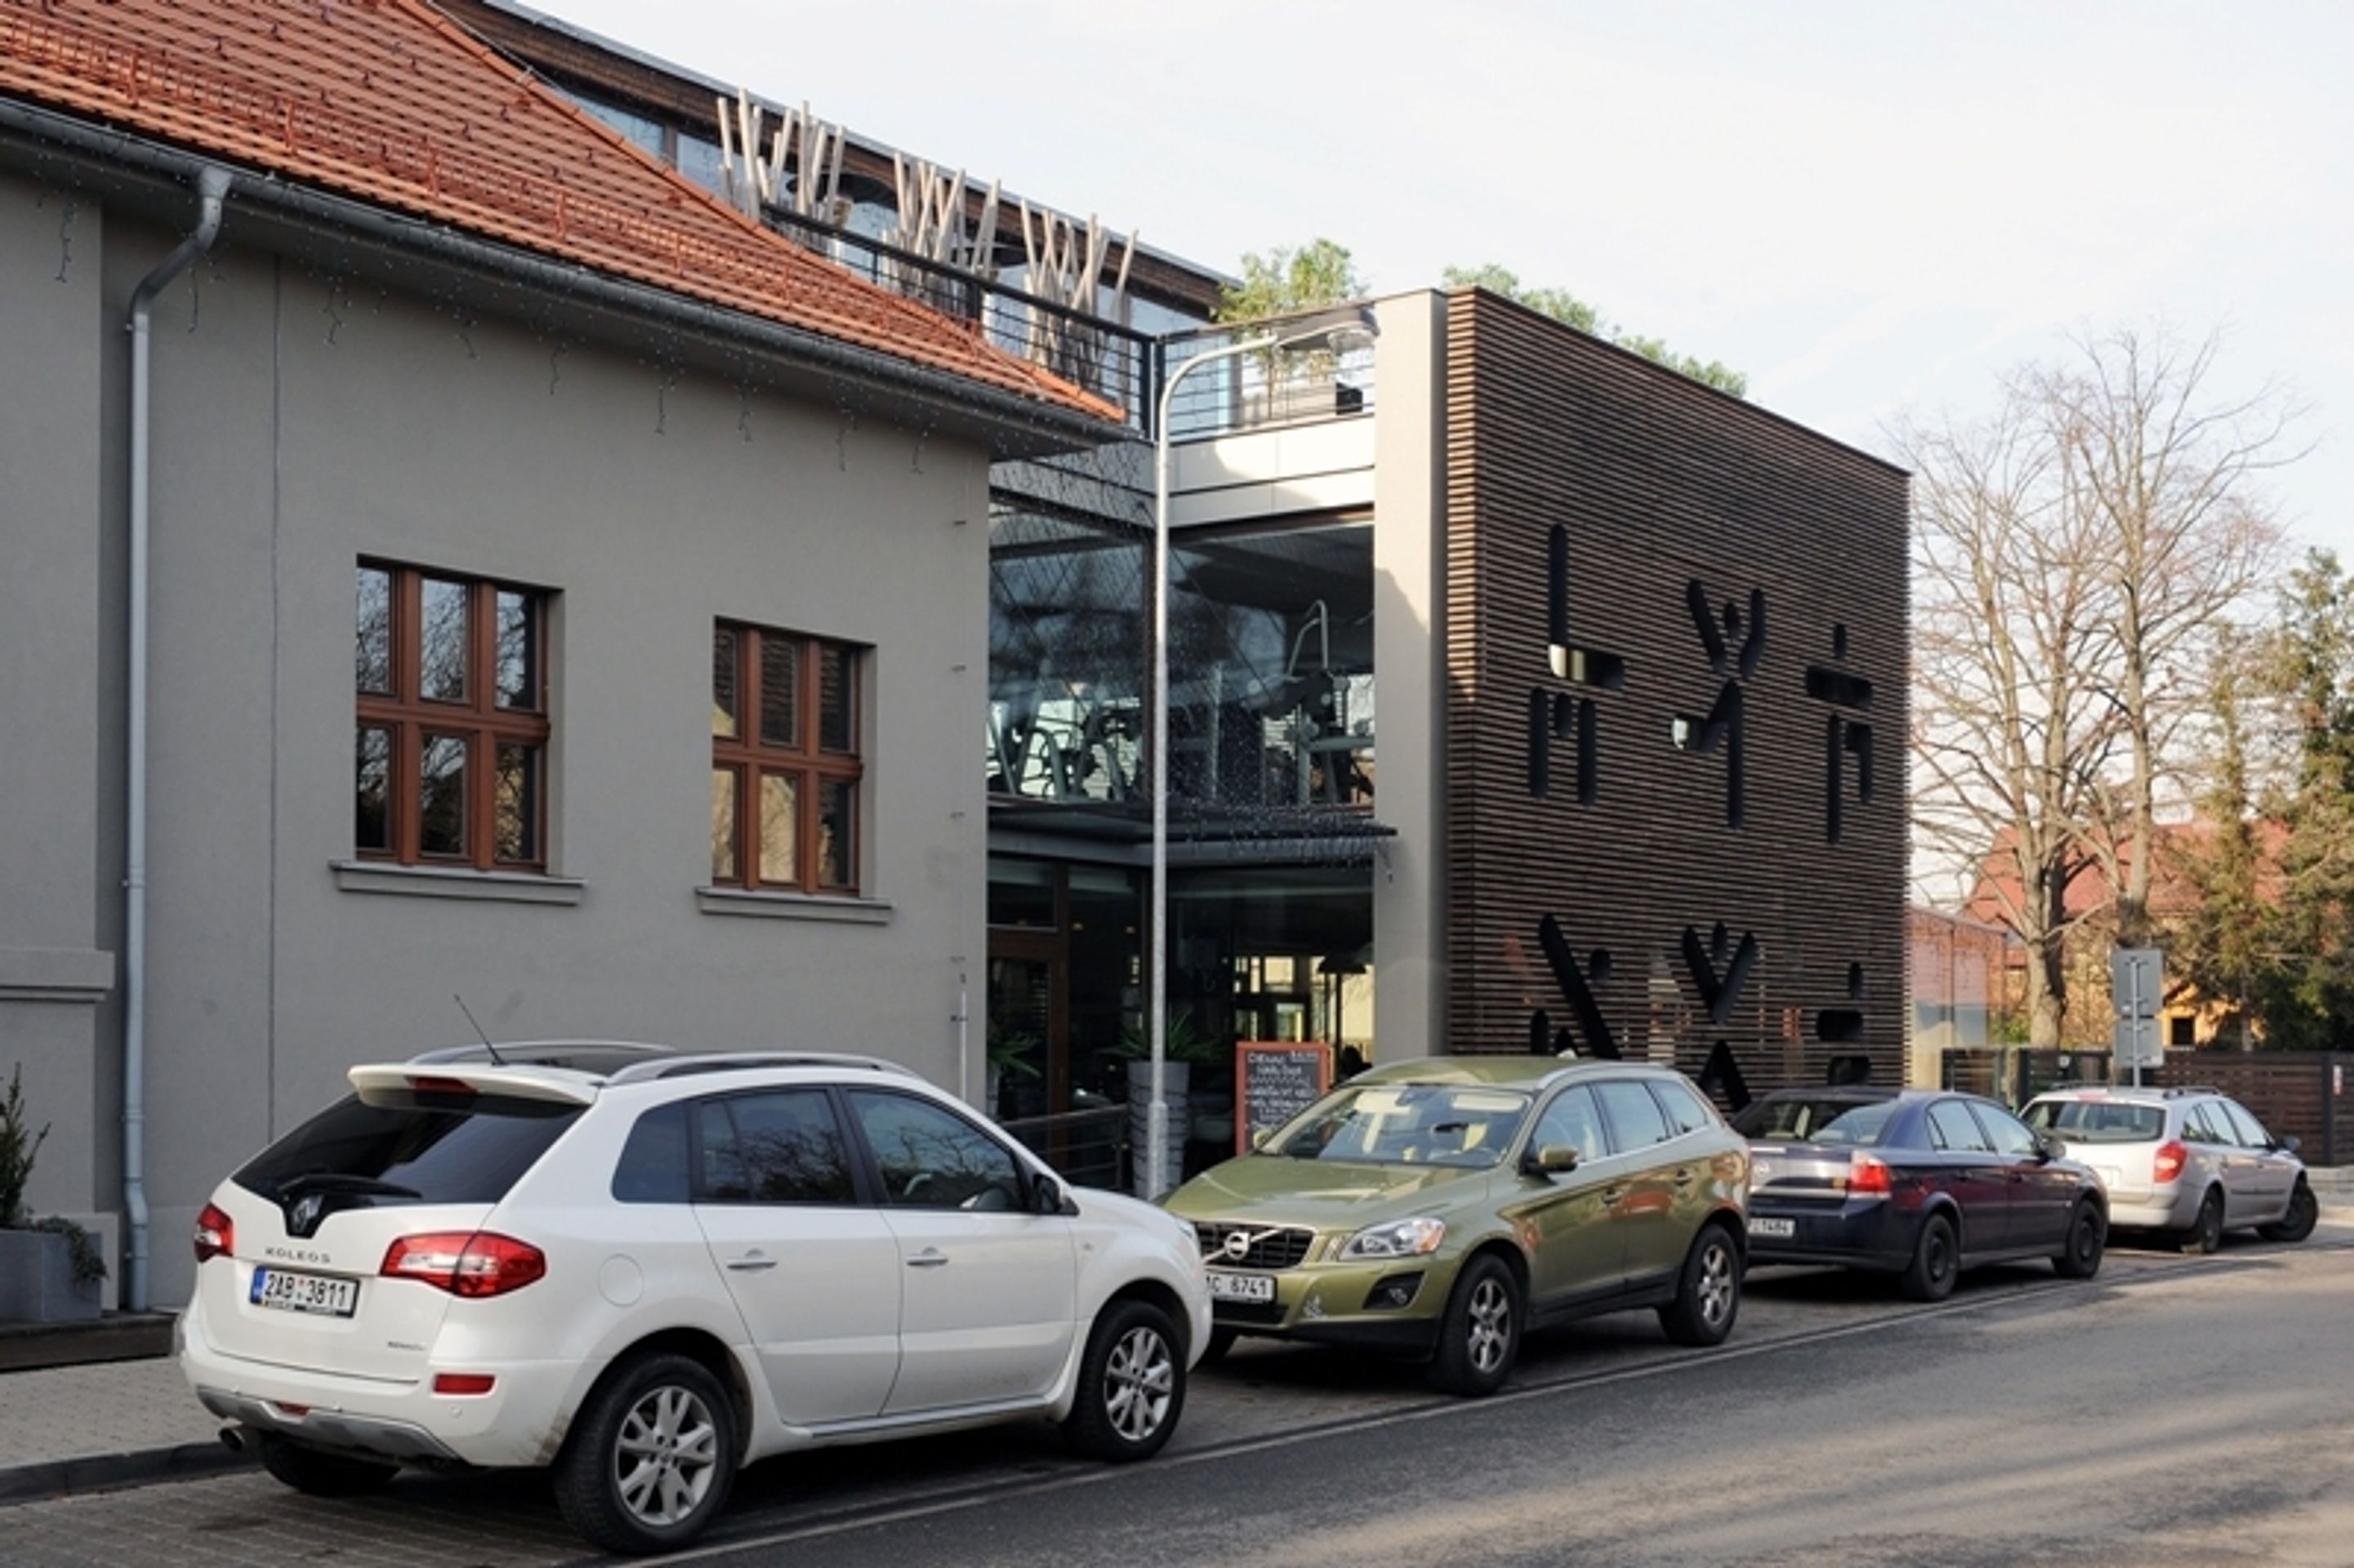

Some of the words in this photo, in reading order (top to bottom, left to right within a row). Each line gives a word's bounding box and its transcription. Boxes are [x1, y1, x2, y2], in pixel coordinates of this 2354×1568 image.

[265, 1247, 331, 1263] KOLEOS
[265, 1273, 295, 1299] 2AB
[305, 1279, 346, 1307] 3811
